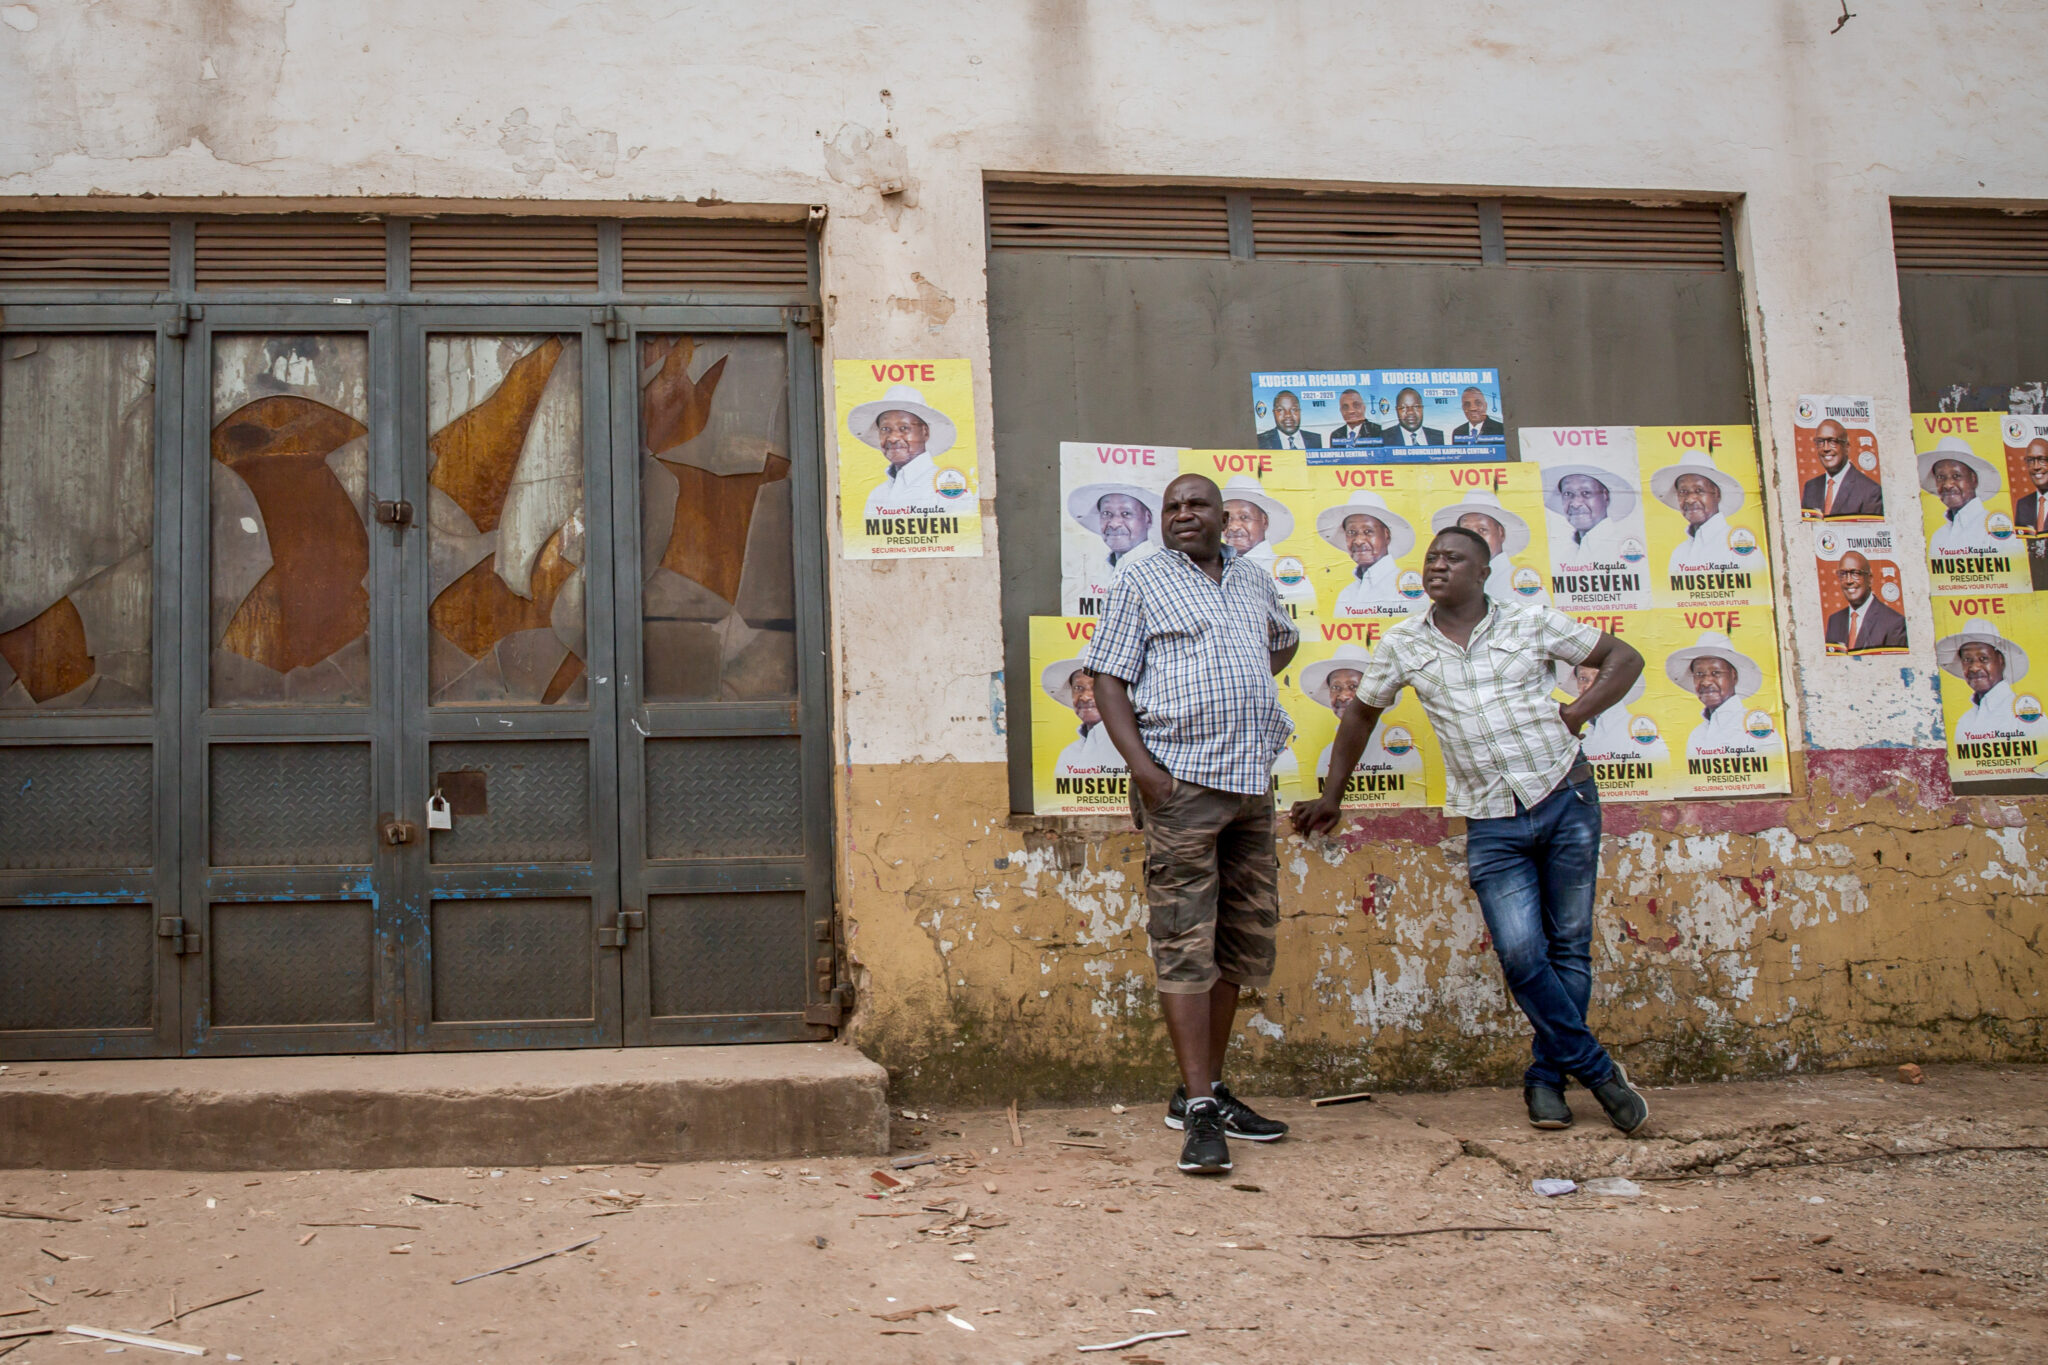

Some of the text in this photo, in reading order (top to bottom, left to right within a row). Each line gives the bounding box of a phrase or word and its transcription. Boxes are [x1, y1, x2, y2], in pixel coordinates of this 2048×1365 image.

[871, 364, 935, 382] VOTE
[1259, 374, 1307, 387] KUDEEBA
[1382, 372, 1429, 384] KUDEEBA
[1825, 407, 1870, 417] TUMUKUNDE
[1924, 417, 1979, 434] VOTE
[1553, 429, 1608, 446] VOTE
[1667, 430, 1722, 447] VOTE
[1097, 447, 1156, 466] VOTE
[1213, 455, 1272, 472] VOTE
[1335, 469, 1394, 487] VOTE
[1450, 468, 1508, 486] VOTE
[866, 517, 959, 535] MUSEVENI
[887, 536, 939, 544] PRESIDENT
[1847, 538, 1892, 548] TUMUKUNDE
[1931, 557, 2010, 574] MUSEVENI
[1552, 574, 1640, 593] MUSEVENI
[1670, 573, 1752, 590] MUSEVENI
[1950, 574, 1994, 582] PRESIDENT
[1571, 593, 1621, 602] PRESIDENT
[1690, 590, 1735, 599] PRESIDENT
[1950, 598, 2005, 616] VOTE
[1577, 616, 1625, 633] OTE
[1684, 611, 1742, 628] VOTE
[1066, 622, 1096, 640] VO
[1321, 623, 1382, 641] VOTE
[1956, 740, 2038, 759] MUSEVENI
[1592, 763, 1653, 780] SEVENI
[1688, 757, 1769, 774] MUSEVENI
[1976, 759, 2021, 768] PRESIDENT
[1056, 777, 1127, 794] MUSEVE
[1707, 775, 1751, 783] PRESIDENT
[1344, 793, 1385, 801] RESIDENT
